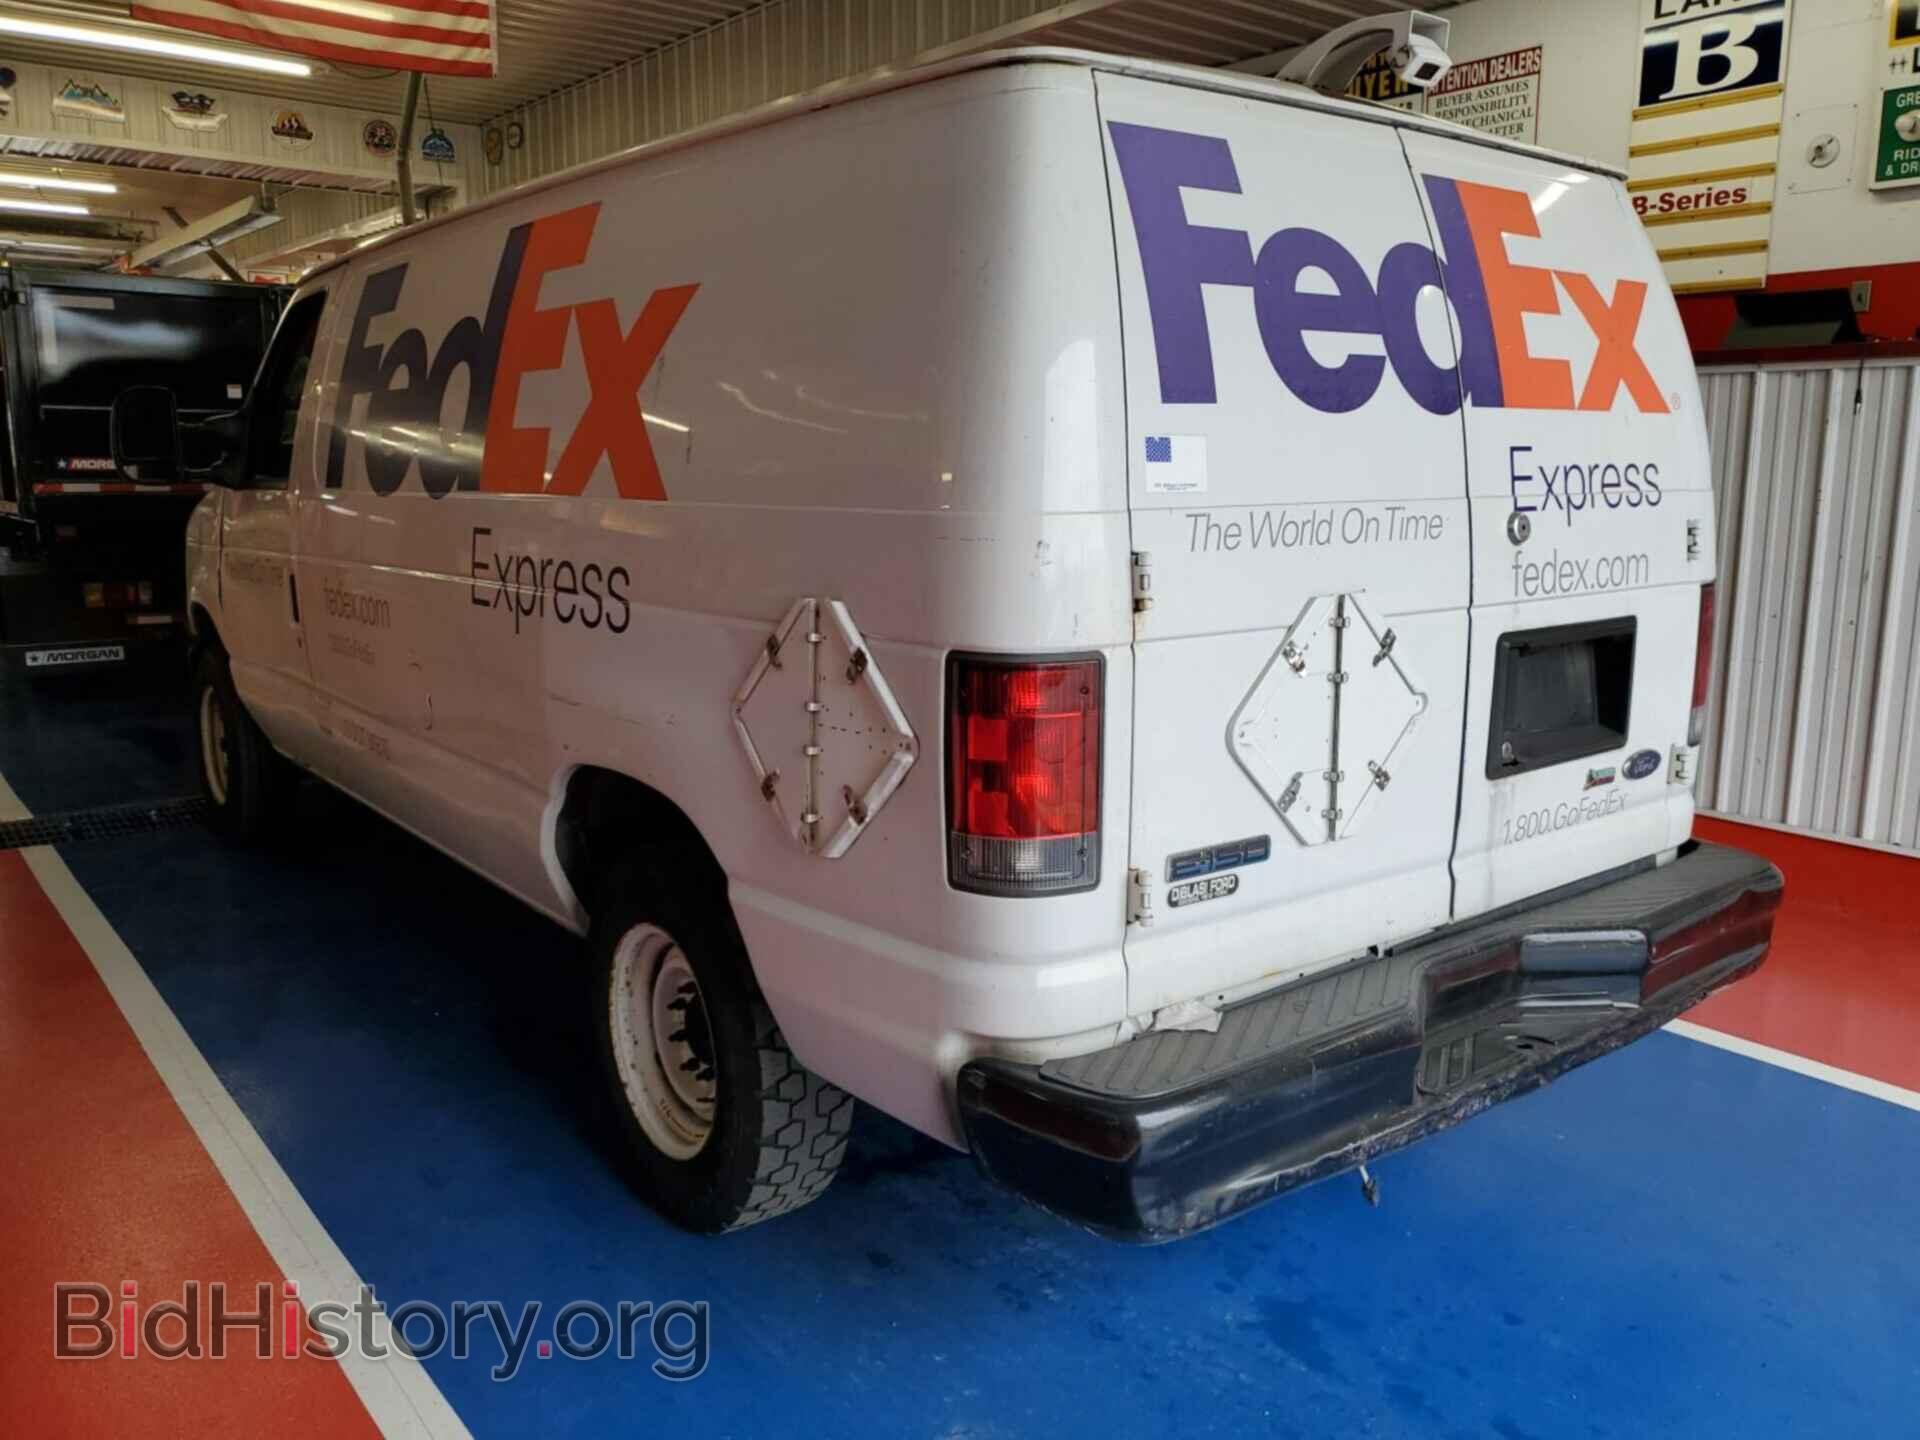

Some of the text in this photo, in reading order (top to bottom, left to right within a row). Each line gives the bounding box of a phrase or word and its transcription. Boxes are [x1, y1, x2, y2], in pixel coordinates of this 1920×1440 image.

[1489, 49, 1541, 81] DEALERS
[1658, 13, 1759, 101] B
[1436, 80, 1530, 109] BUYER ASSUMES
[1632, 186, 1748, 216] B-Series
[1107, 120, 1671, 415] FedEx
[325, 200, 702, 500] FedEx
[1509, 446, 1662, 527] Express
[1185, 505, 1445, 552] The World On Time
[470, 526, 632, 634] Express
[1511, 548, 1650, 598] fedex.com
[46, 649, 121, 664] MORGAN
[1502, 787, 1629, 846] 1.800.GoFedEx
[1210, 874, 1236, 893] FORD
